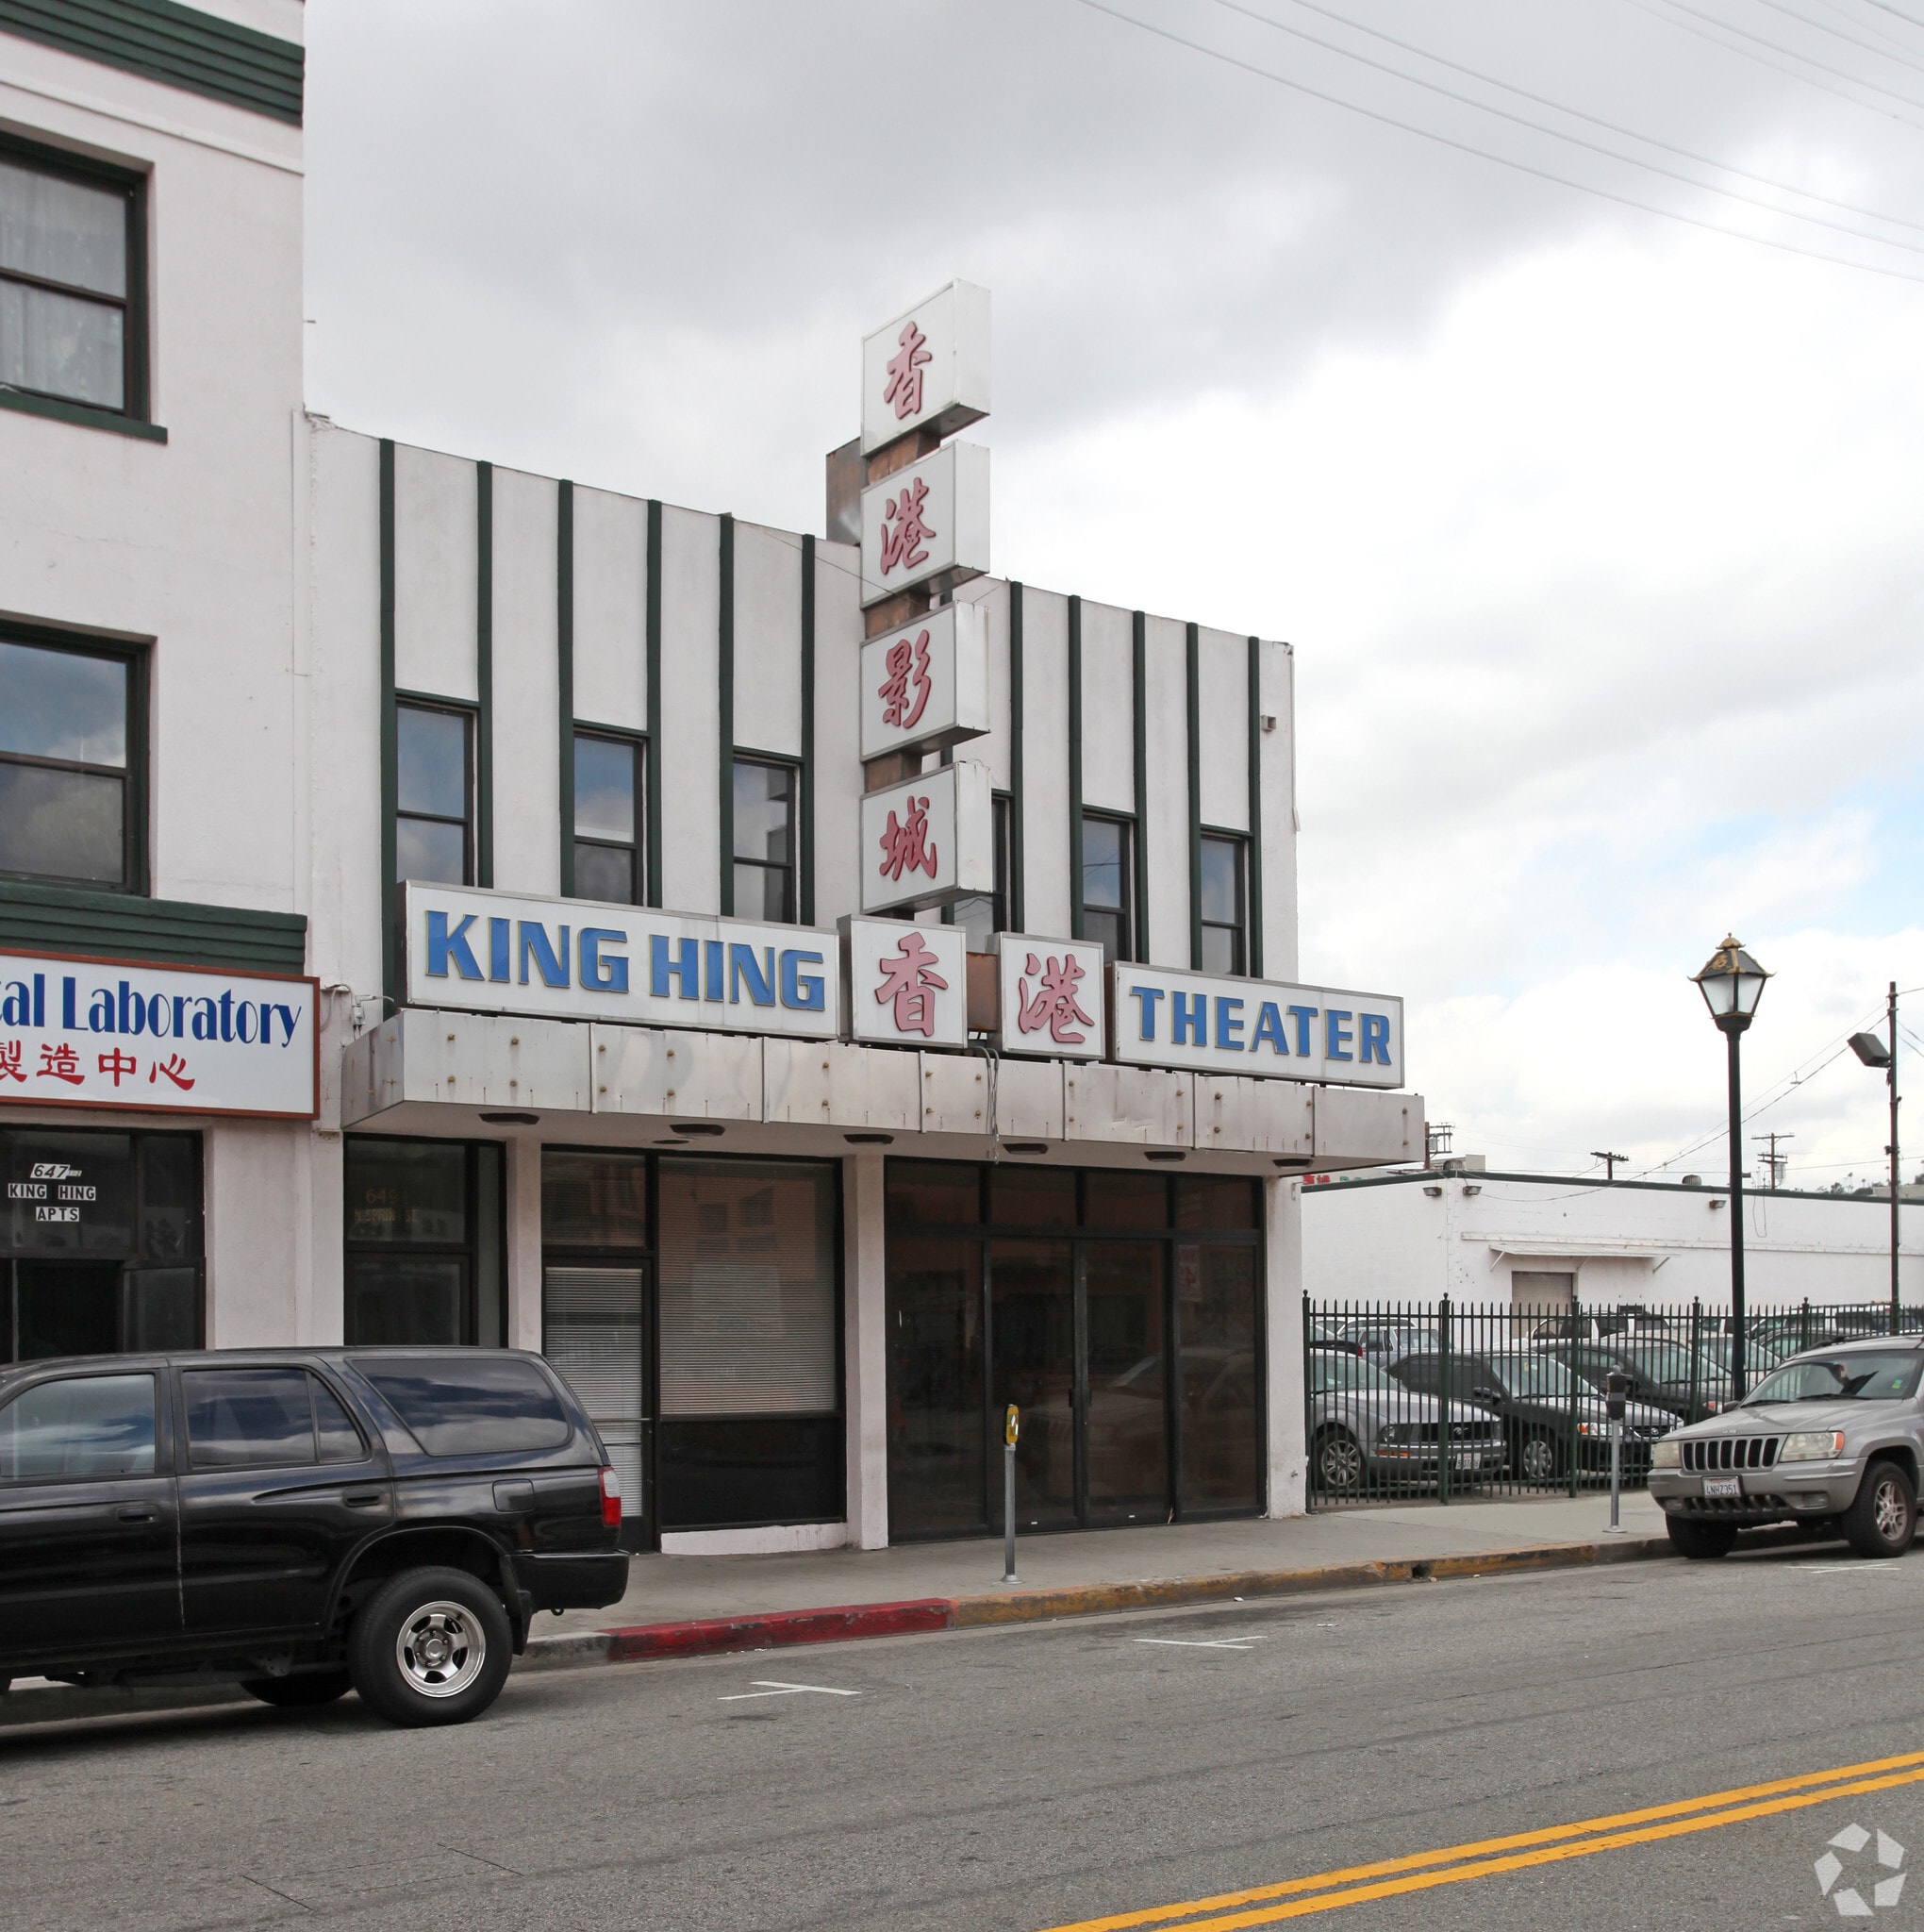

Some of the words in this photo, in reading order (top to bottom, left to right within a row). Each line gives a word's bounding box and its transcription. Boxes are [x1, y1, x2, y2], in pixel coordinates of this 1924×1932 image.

[423, 909, 630, 994] KING
[649, 933, 826, 1012] HING
[0, 973, 45, 1028] al
[62, 975, 302, 1048] Laboratory
[1129, 985, 1392, 1066] THEATER
[9, 1184, 46, 1198] KING
[59, 1185, 95, 1200] HING
[34, 1164, 69, 1178] 647
[38, 1208, 78, 1221] APTS
